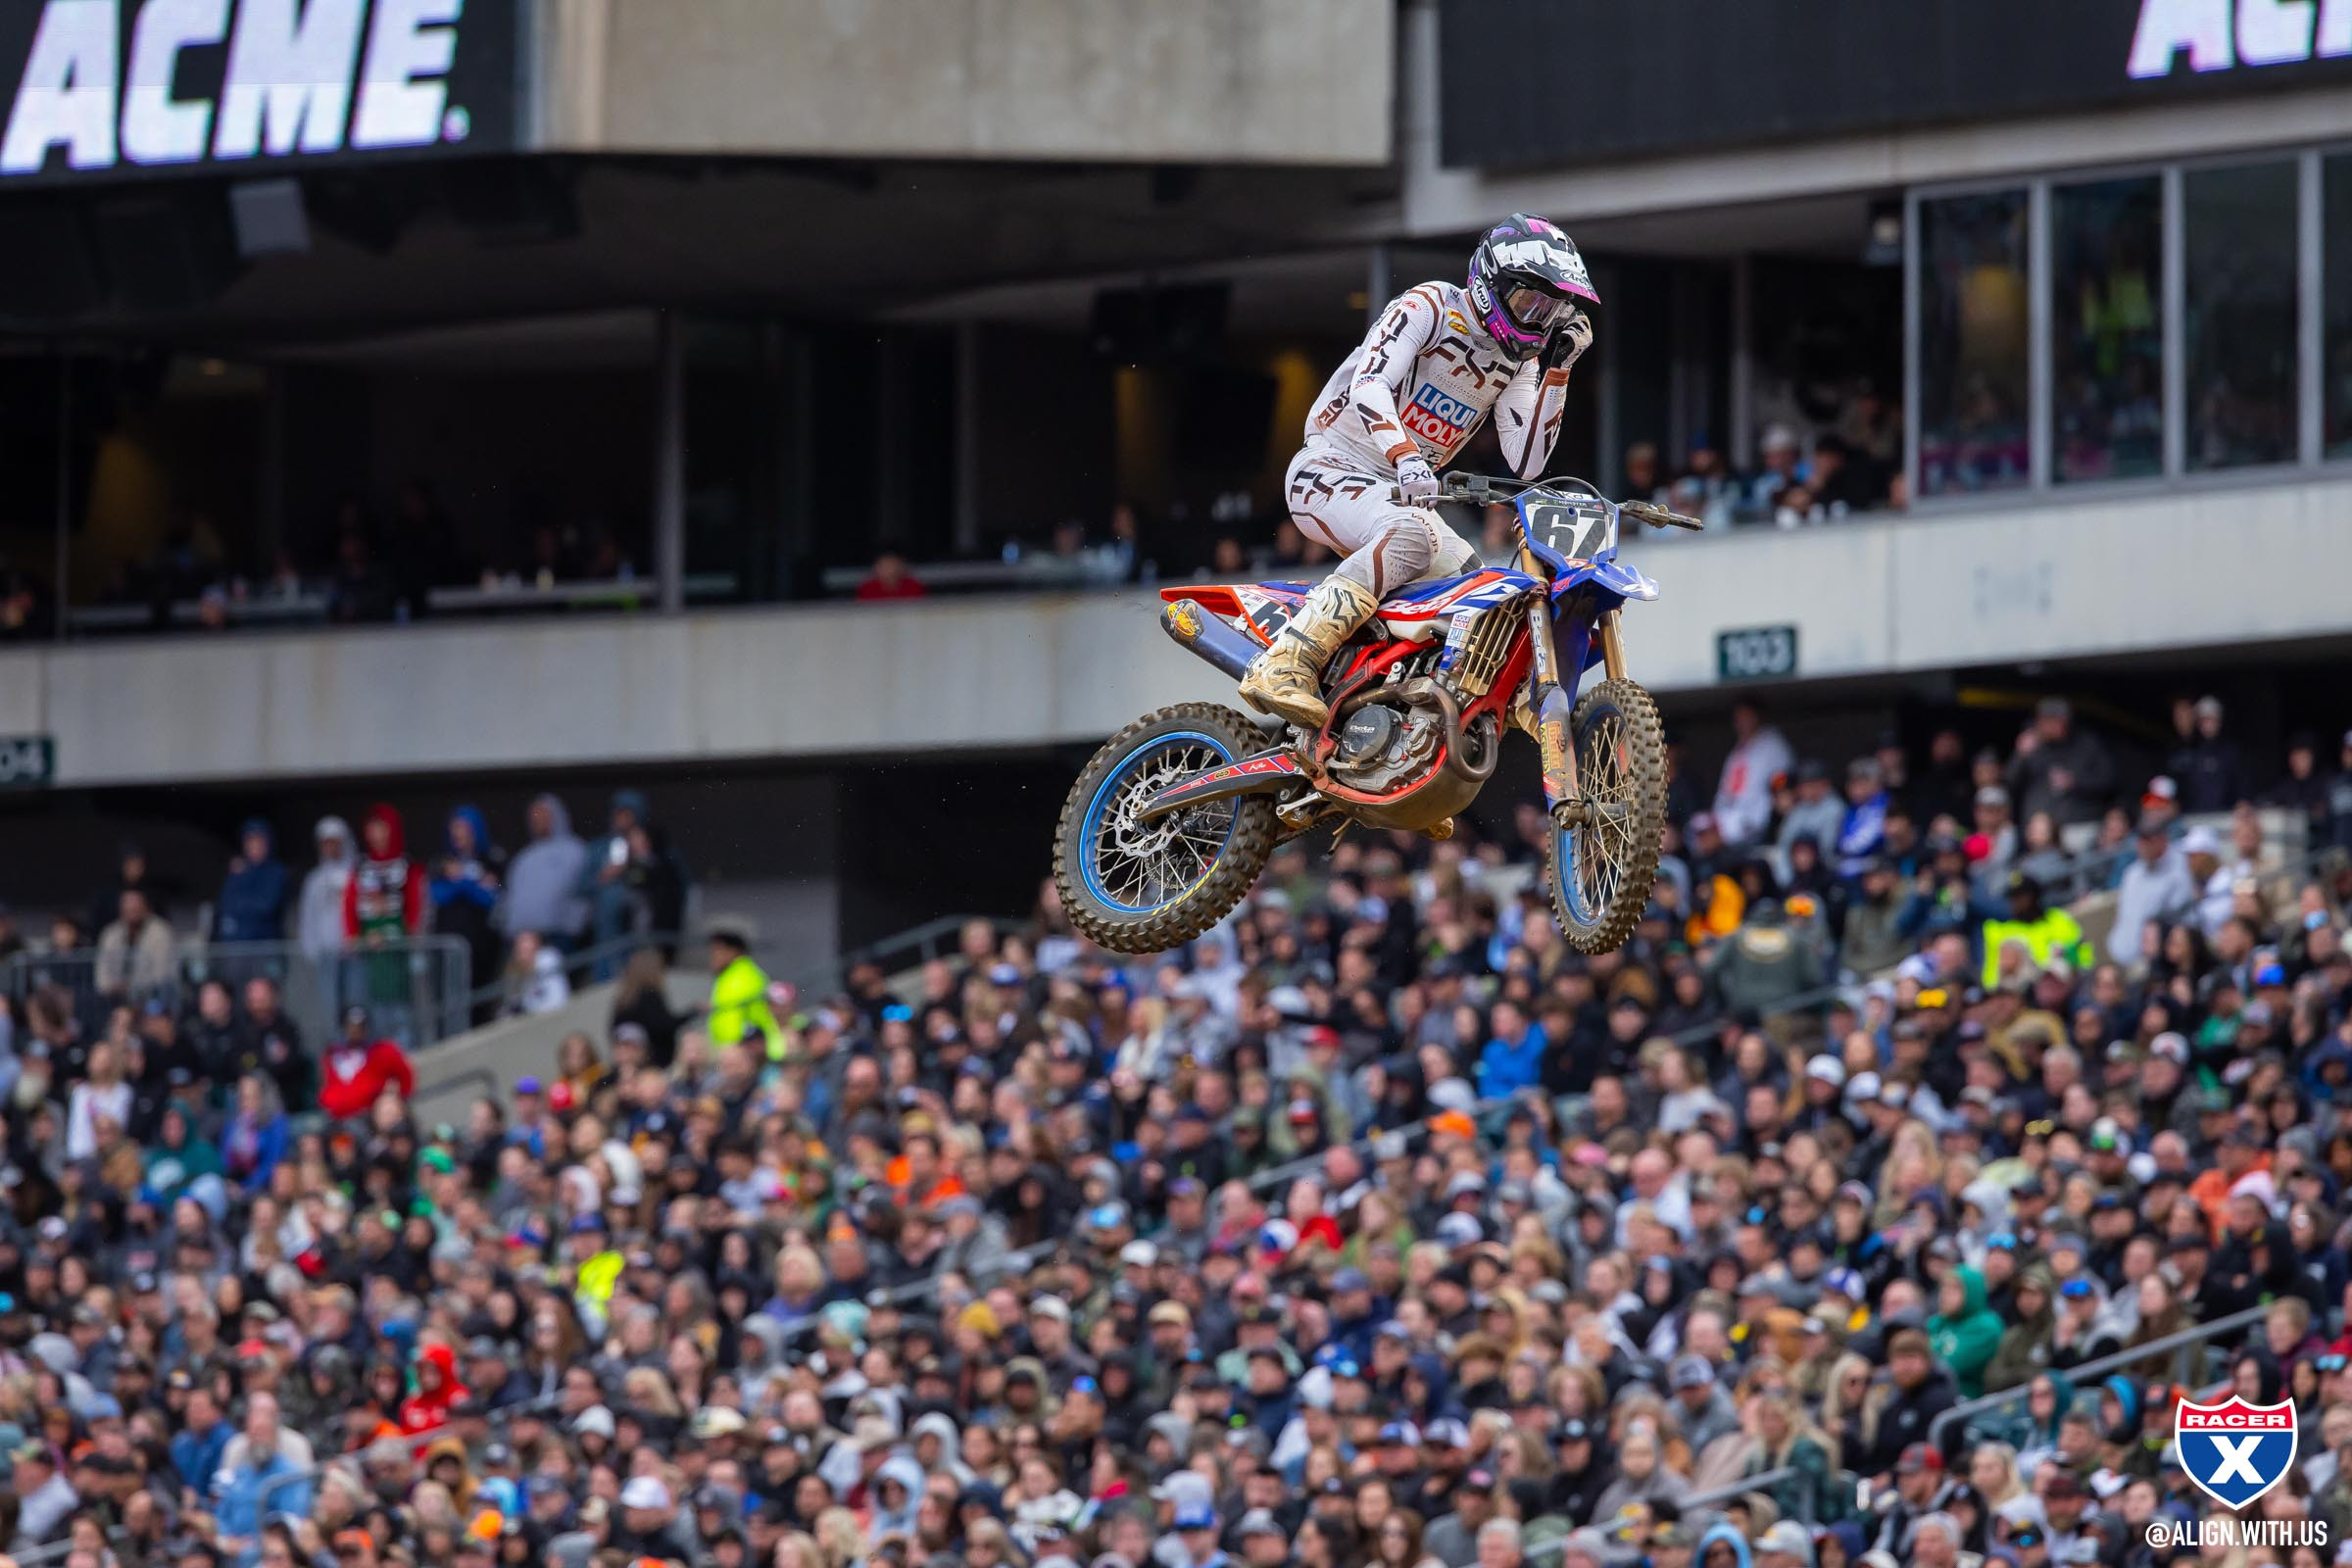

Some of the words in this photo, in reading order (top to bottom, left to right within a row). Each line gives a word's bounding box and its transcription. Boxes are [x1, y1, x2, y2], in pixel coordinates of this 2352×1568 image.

[1474, 279, 1490, 306] Arai
[1403, 404, 1463, 448] MOLY
[1417, 385, 1477, 430] LIQUI
[1411, 512, 1439, 554] VAPOR
[1531, 506, 1615, 560] 67
[1378, 596, 1452, 615] Beta
[1529, 609, 1547, 674] Beta
